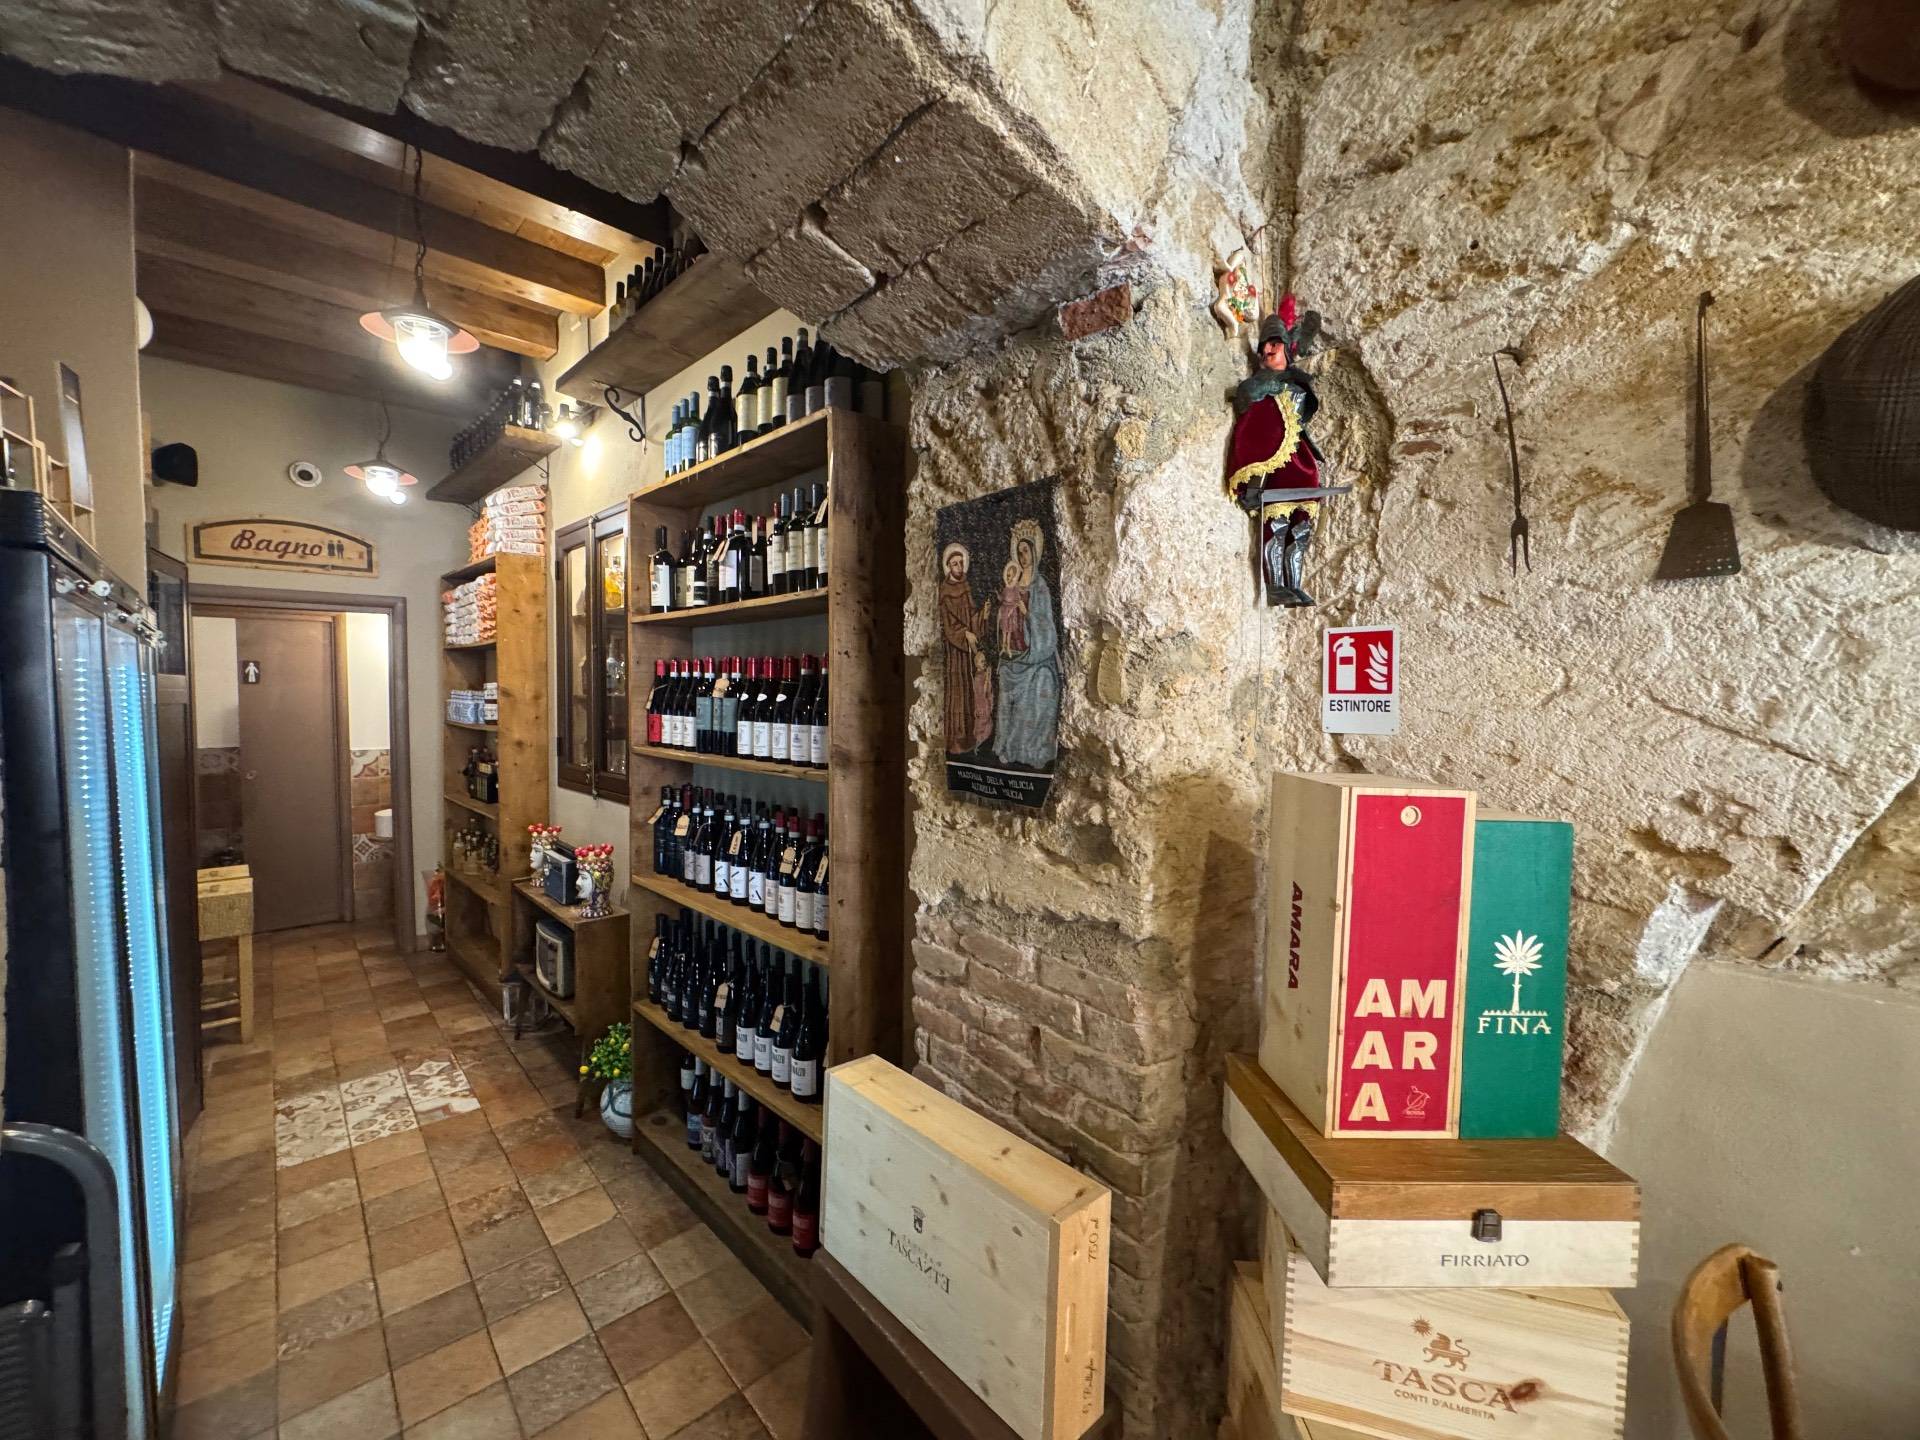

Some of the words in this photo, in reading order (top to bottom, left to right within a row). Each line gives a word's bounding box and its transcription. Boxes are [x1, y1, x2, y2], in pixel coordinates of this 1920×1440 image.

[231, 529, 323, 559] Bagno
[1329, 699, 1391, 712] ESTINTORE
[1287, 880, 1303, 989] AMARA
[1353, 978, 1448, 1019] AM
[1477, 1017, 1551, 1035] FINA
[1350, 1030, 1438, 1070] AR
[1347, 1082, 1391, 1122] A
[1088, 1233, 1098, 1263] 750
[1440, 1254, 1530, 1267] FIRRIATO
[1372, 1358, 1518, 1414] TASCA
[1394, 1388, 1428, 1404] CONTI
[1431, 1397, 1496, 1421] D'ALMERITA
